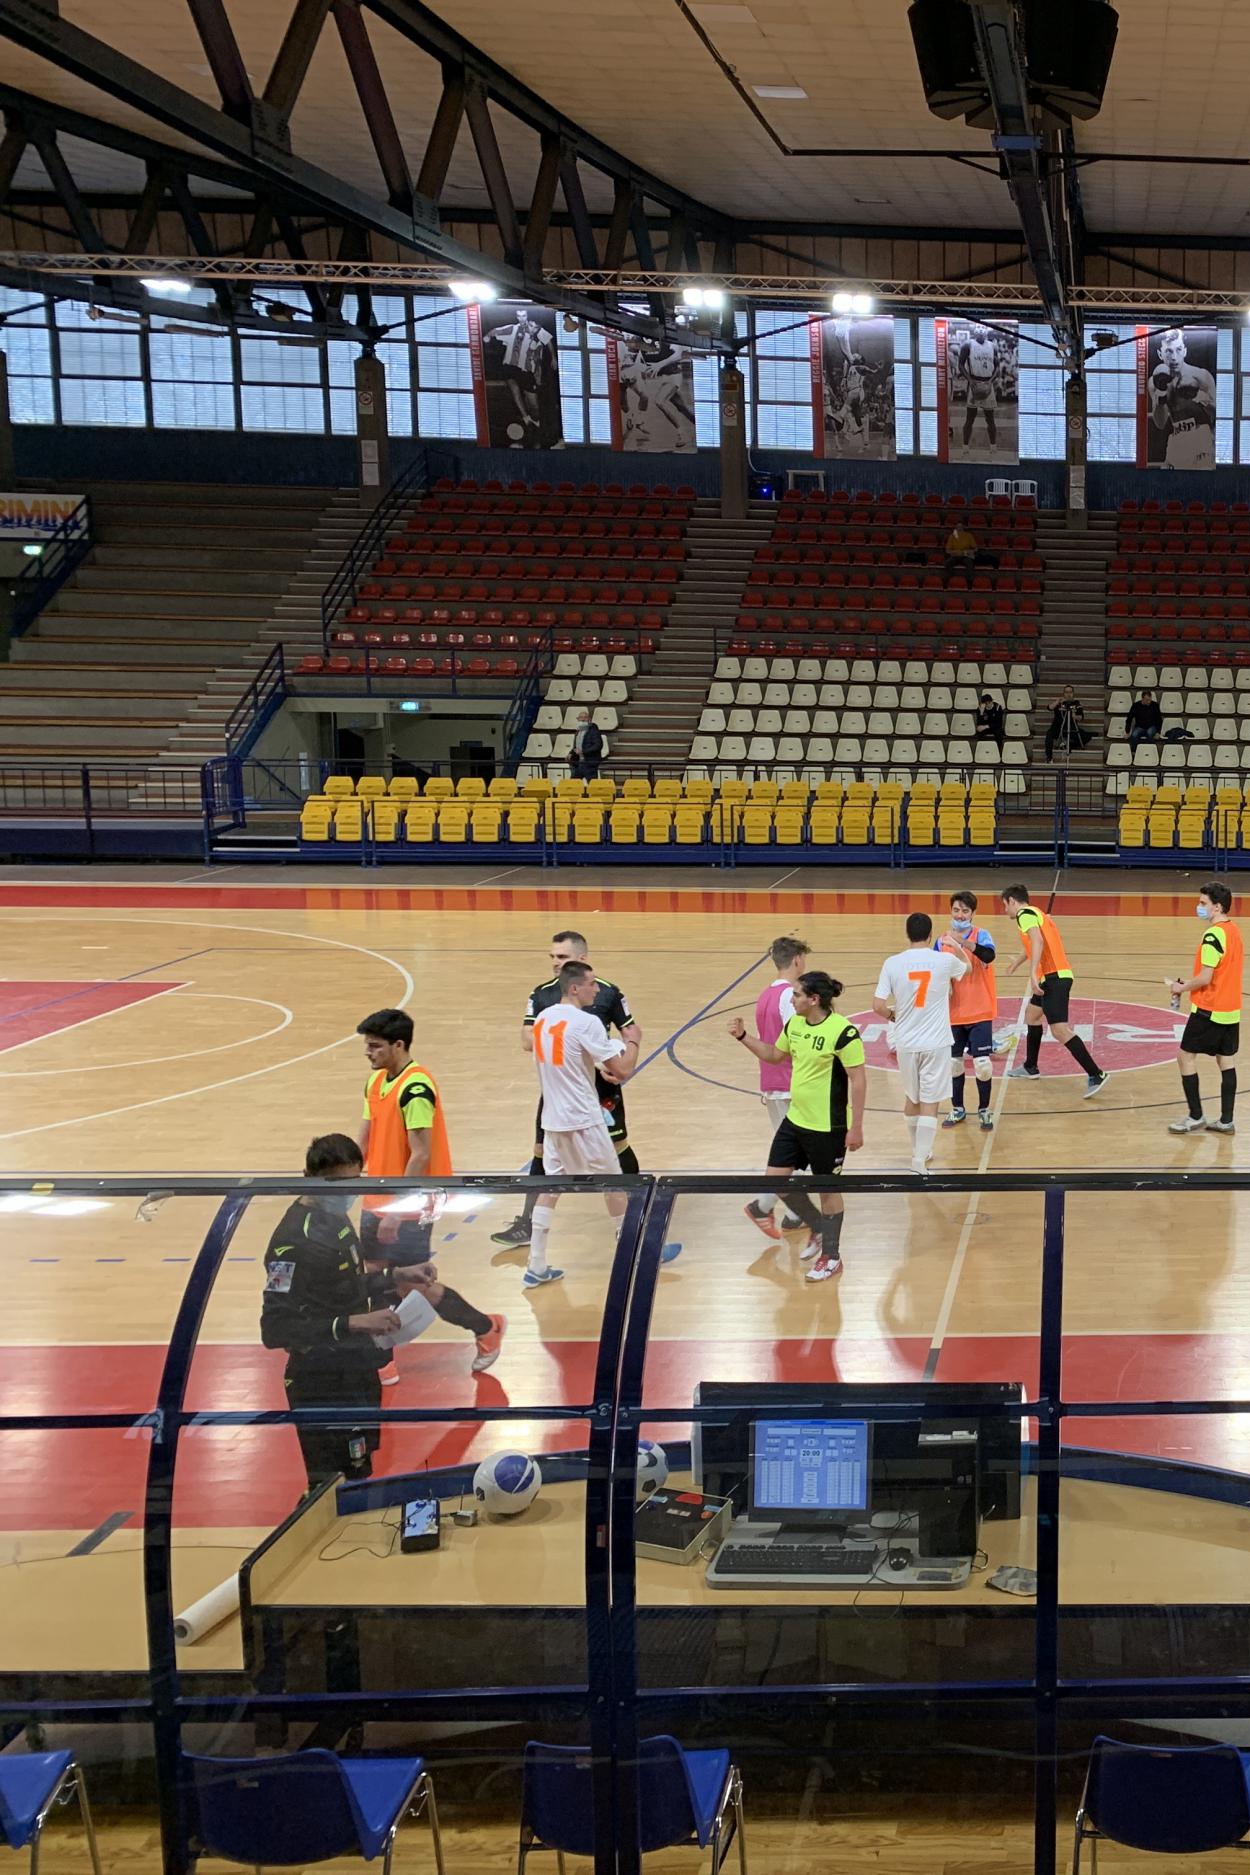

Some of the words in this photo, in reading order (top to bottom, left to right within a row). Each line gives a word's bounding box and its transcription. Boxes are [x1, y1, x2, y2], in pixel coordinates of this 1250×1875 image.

[607, 345, 616, 361] LUCA
[810, 322, 820, 357] JOHNSON
[937, 327, 946, 366] MIDDLETON
[1138, 336, 1146, 359] STECC
[811, 358, 821, 382] REGGIE
[1138, 360, 1146, 394] MAURIZIO
[907, 970, 932, 1009] 7
[532, 1018, 568, 1067] 11
[811, 1035, 826, 1051] 19
